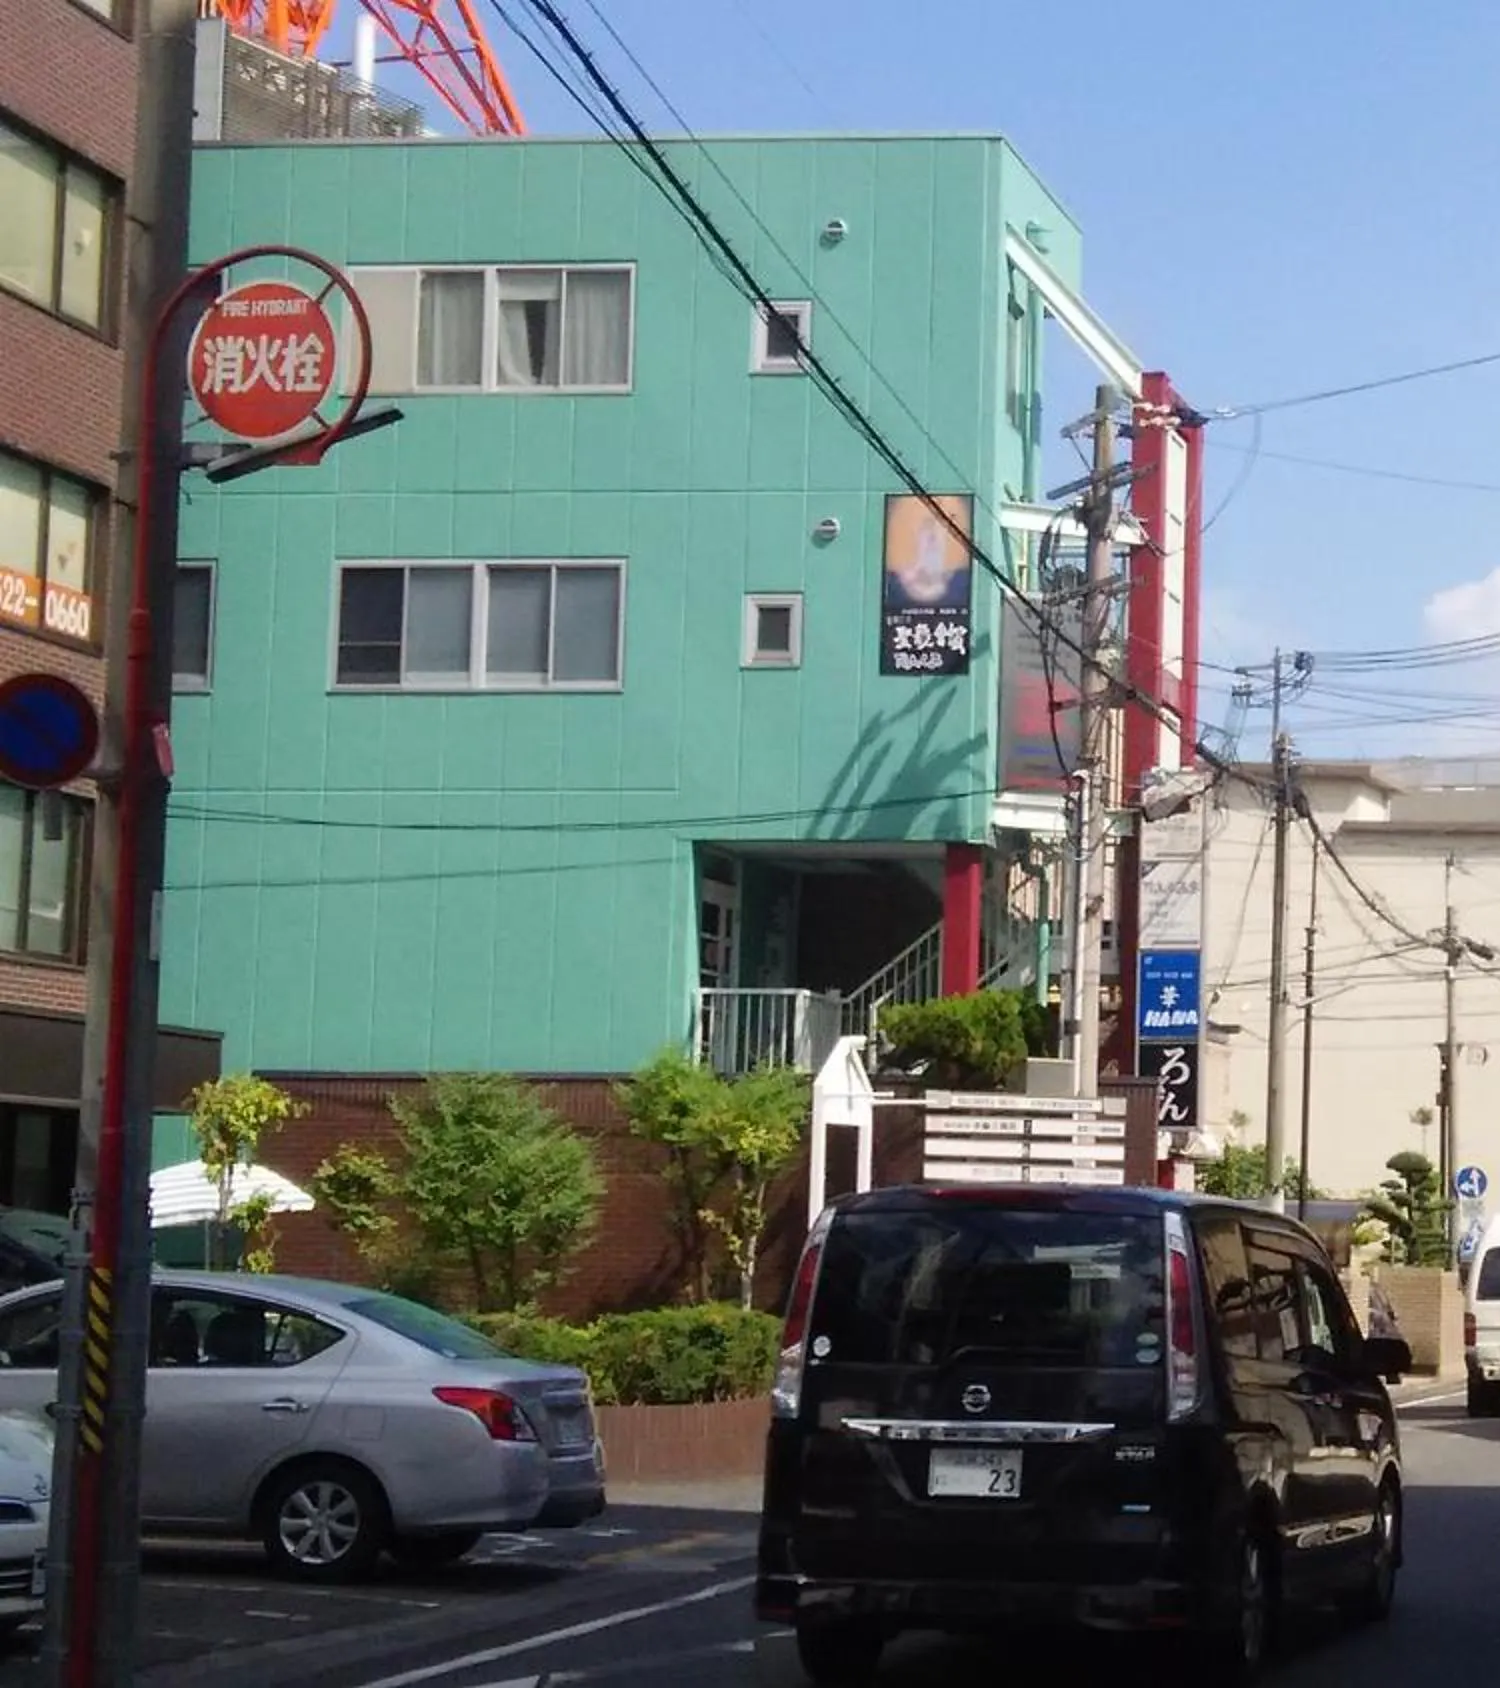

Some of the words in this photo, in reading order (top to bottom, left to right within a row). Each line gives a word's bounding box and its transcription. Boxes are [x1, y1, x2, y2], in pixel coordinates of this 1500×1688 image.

[222, 300, 250, 317] FIRE
[251, 299, 310, 317] HYDRANT
[201, 333, 325, 394] 消火栓
[0, 573, 91, 638] 22-0660
[1144, 1010, 1198, 1027] HANA
[988, 1469, 1016, 1493] 23
